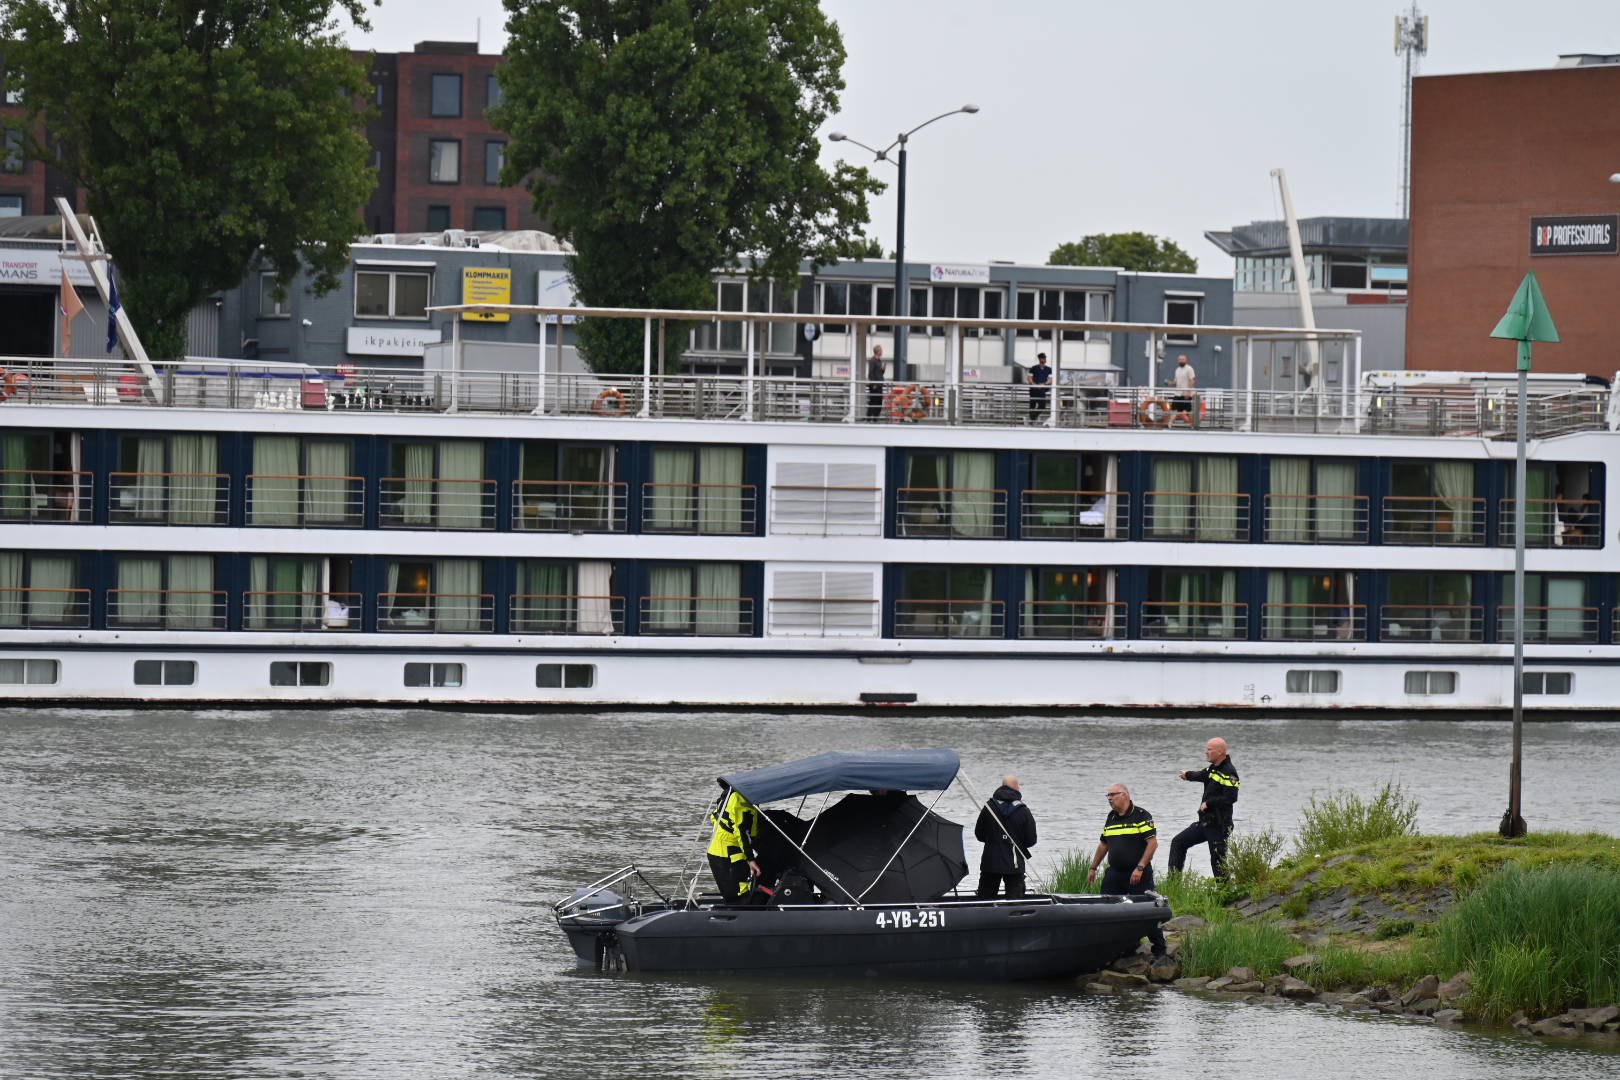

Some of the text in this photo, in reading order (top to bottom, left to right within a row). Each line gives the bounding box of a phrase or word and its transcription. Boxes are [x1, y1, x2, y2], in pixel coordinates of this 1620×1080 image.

[1553, 224, 1610, 246] PROFESSIONALS
[2, 261, 38, 269] TRANSPORT
[465, 271, 508, 279] KLOMPMAKER
[876, 910, 945, 929] 4-YB-251
